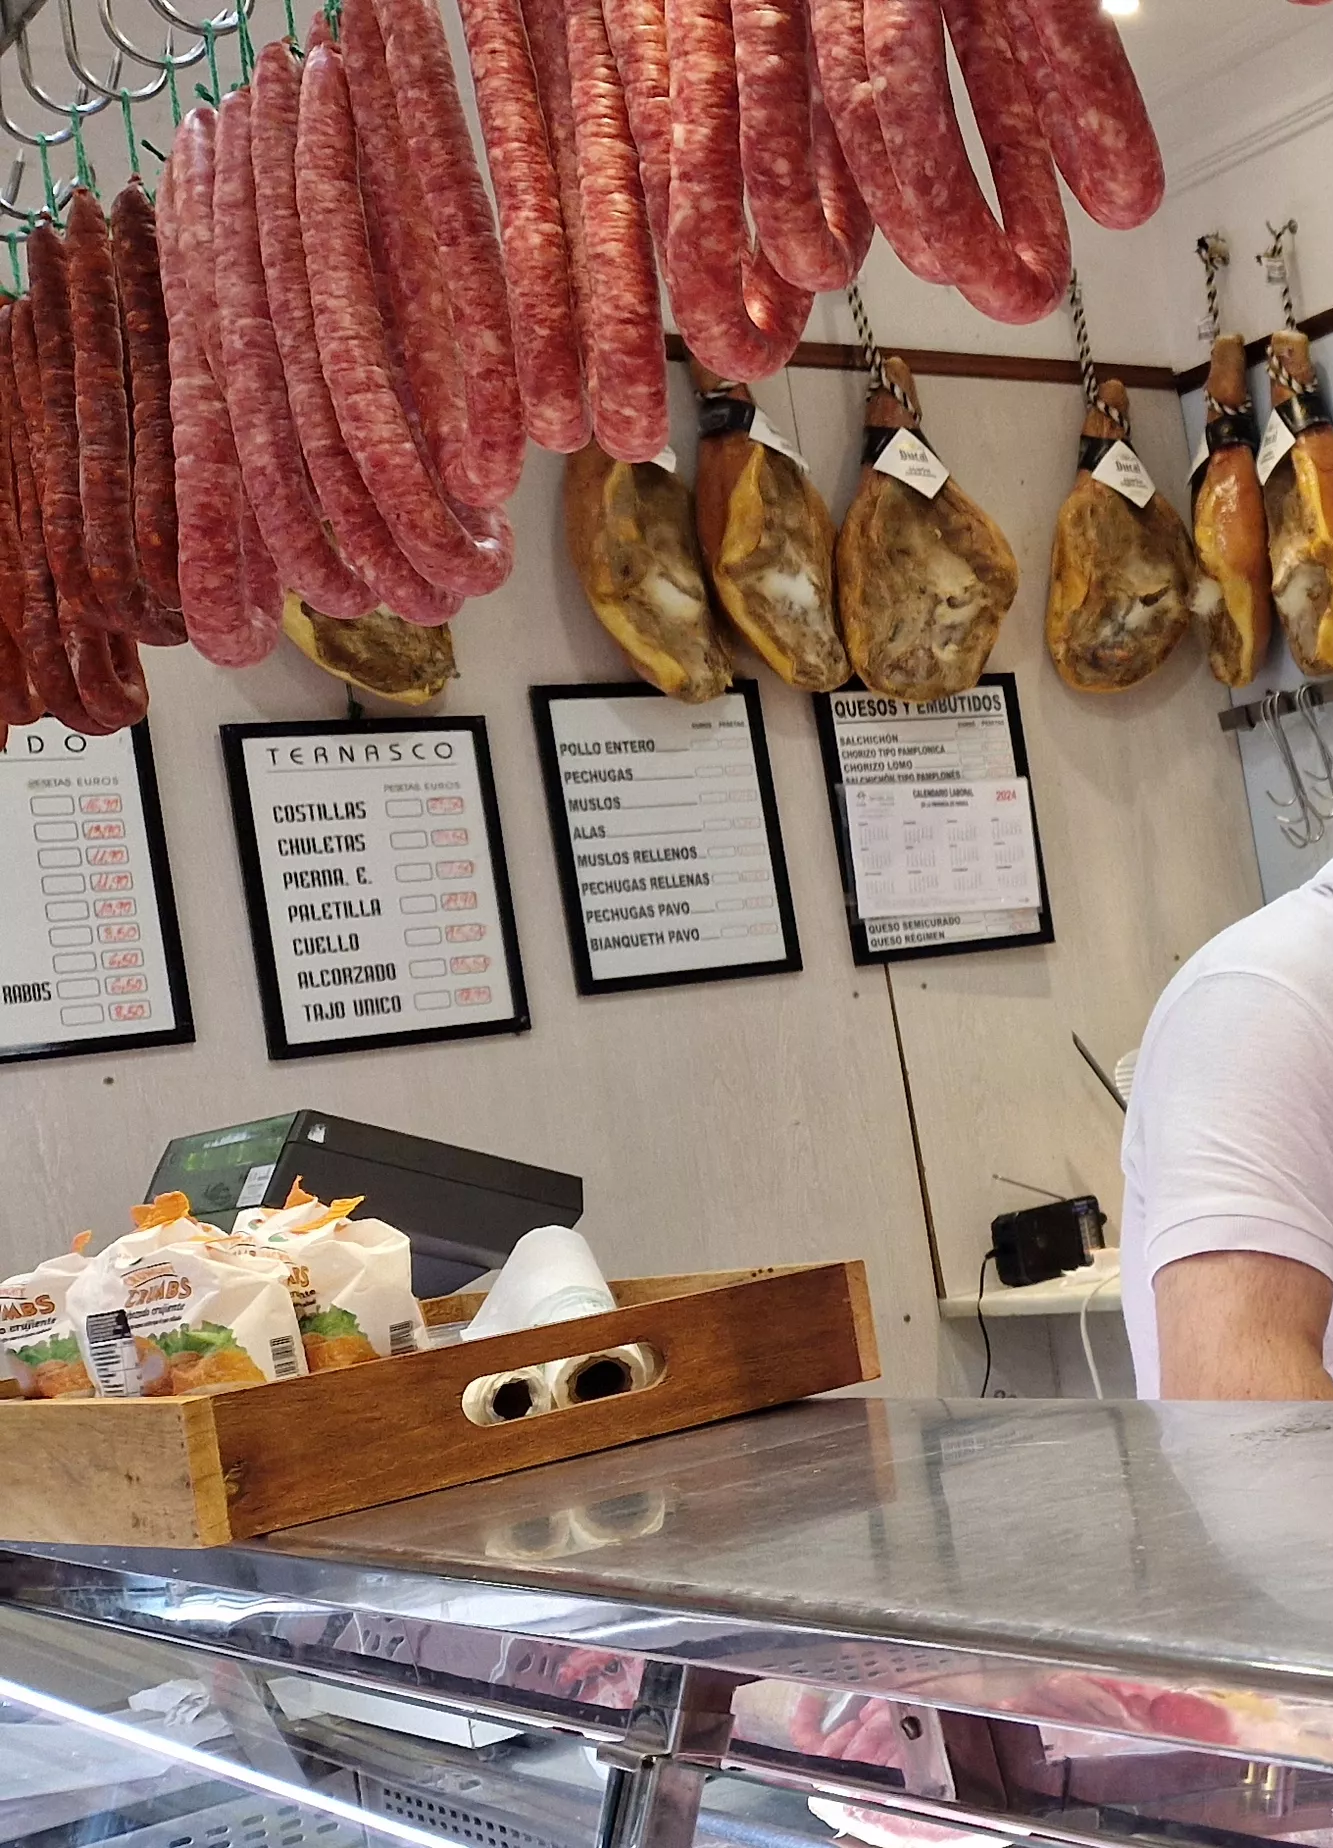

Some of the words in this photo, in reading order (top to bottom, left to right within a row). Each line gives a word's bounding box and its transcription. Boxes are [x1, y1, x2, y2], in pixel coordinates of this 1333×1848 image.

[834, 699, 898, 719] QUESOS
[917, 694, 1002, 715] EMBUTIDOS
[2, 734, 87, 755] DO
[559, 741, 602, 756] POLLO
[605, 739, 655, 755] ENTERO
[840, 734, 899, 747] SALCHICHÓN
[266, 742, 454, 766] TERNASCO
[842, 749, 877, 760] CHORIZO
[878, 747, 897, 758] TIPO
[564, 768, 634, 785] PECHUGAS
[844, 761, 885, 773] CHORIZO
[887, 760, 913, 771] LOMO
[77, 776, 119, 787] EUROS
[568, 796, 621, 812] MUSLOS
[996, 790, 1017, 801] 2024
[272, 801, 367, 824] COSTILLAS
[573, 825, 607, 841] ALAS
[278, 834, 366, 857] CHULETAS
[577, 850, 630, 868] MUSLOS
[633, 846, 698, 864] RELLENOS
[581, 878, 647, 896] PECHUGAS
[650, 872, 710, 890] RELLENAS
[287, 898, 382, 923] PALETILLA
[585, 905, 655, 924] PECHUGAS
[659, 901, 690, 917] PAVO
[668, 928, 700, 944] PAVO
[868, 922, 900, 935] QUESO
[903, 916, 961, 931] SEMICURADO
[292, 933, 360, 956] CUELLO
[871, 935, 902, 948] QUESO
[297, 962, 397, 990] ALCORZADO
[2, 982, 52, 1005] RABOS
[303, 1001, 346, 1022] TAJO
[353, 995, 402, 1017] UNICO
[0, 1294, 56, 1321] MBS
[9, 1317, 57, 1333] crujiente
